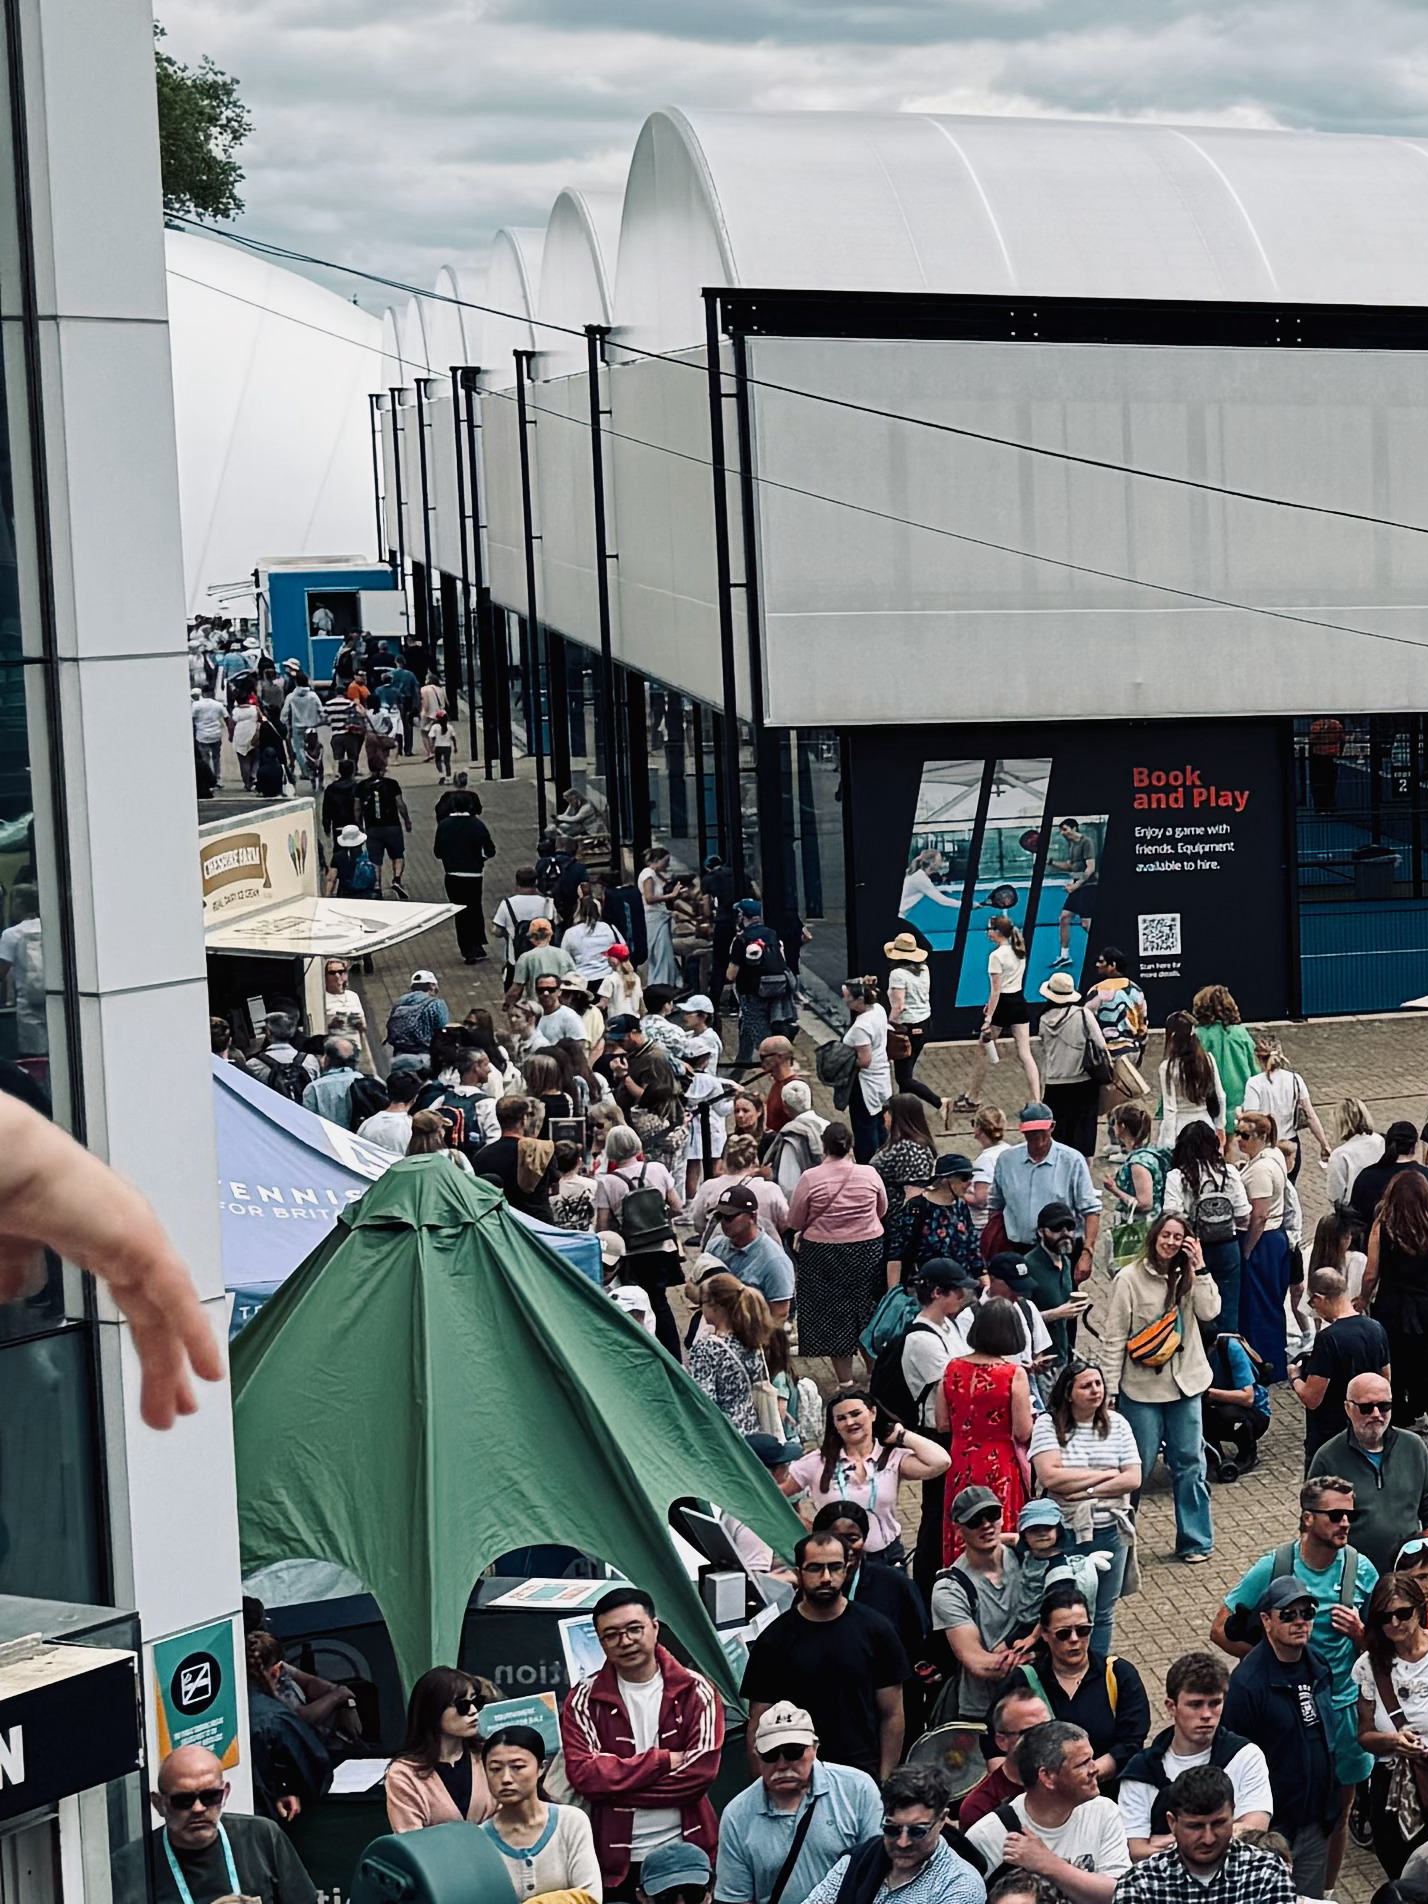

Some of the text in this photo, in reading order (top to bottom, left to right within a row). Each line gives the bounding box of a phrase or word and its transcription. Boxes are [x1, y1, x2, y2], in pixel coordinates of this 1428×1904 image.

[1133, 765, 1202, 787] Book
[1399, 779, 1407, 792] 2
[1133, 786, 1250, 812] and Play
[1134, 824, 1231, 840] Enjoy a game with
[1135, 842, 1235, 856] friends. Equipment
[1135, 859, 1220, 872] available to hire.
